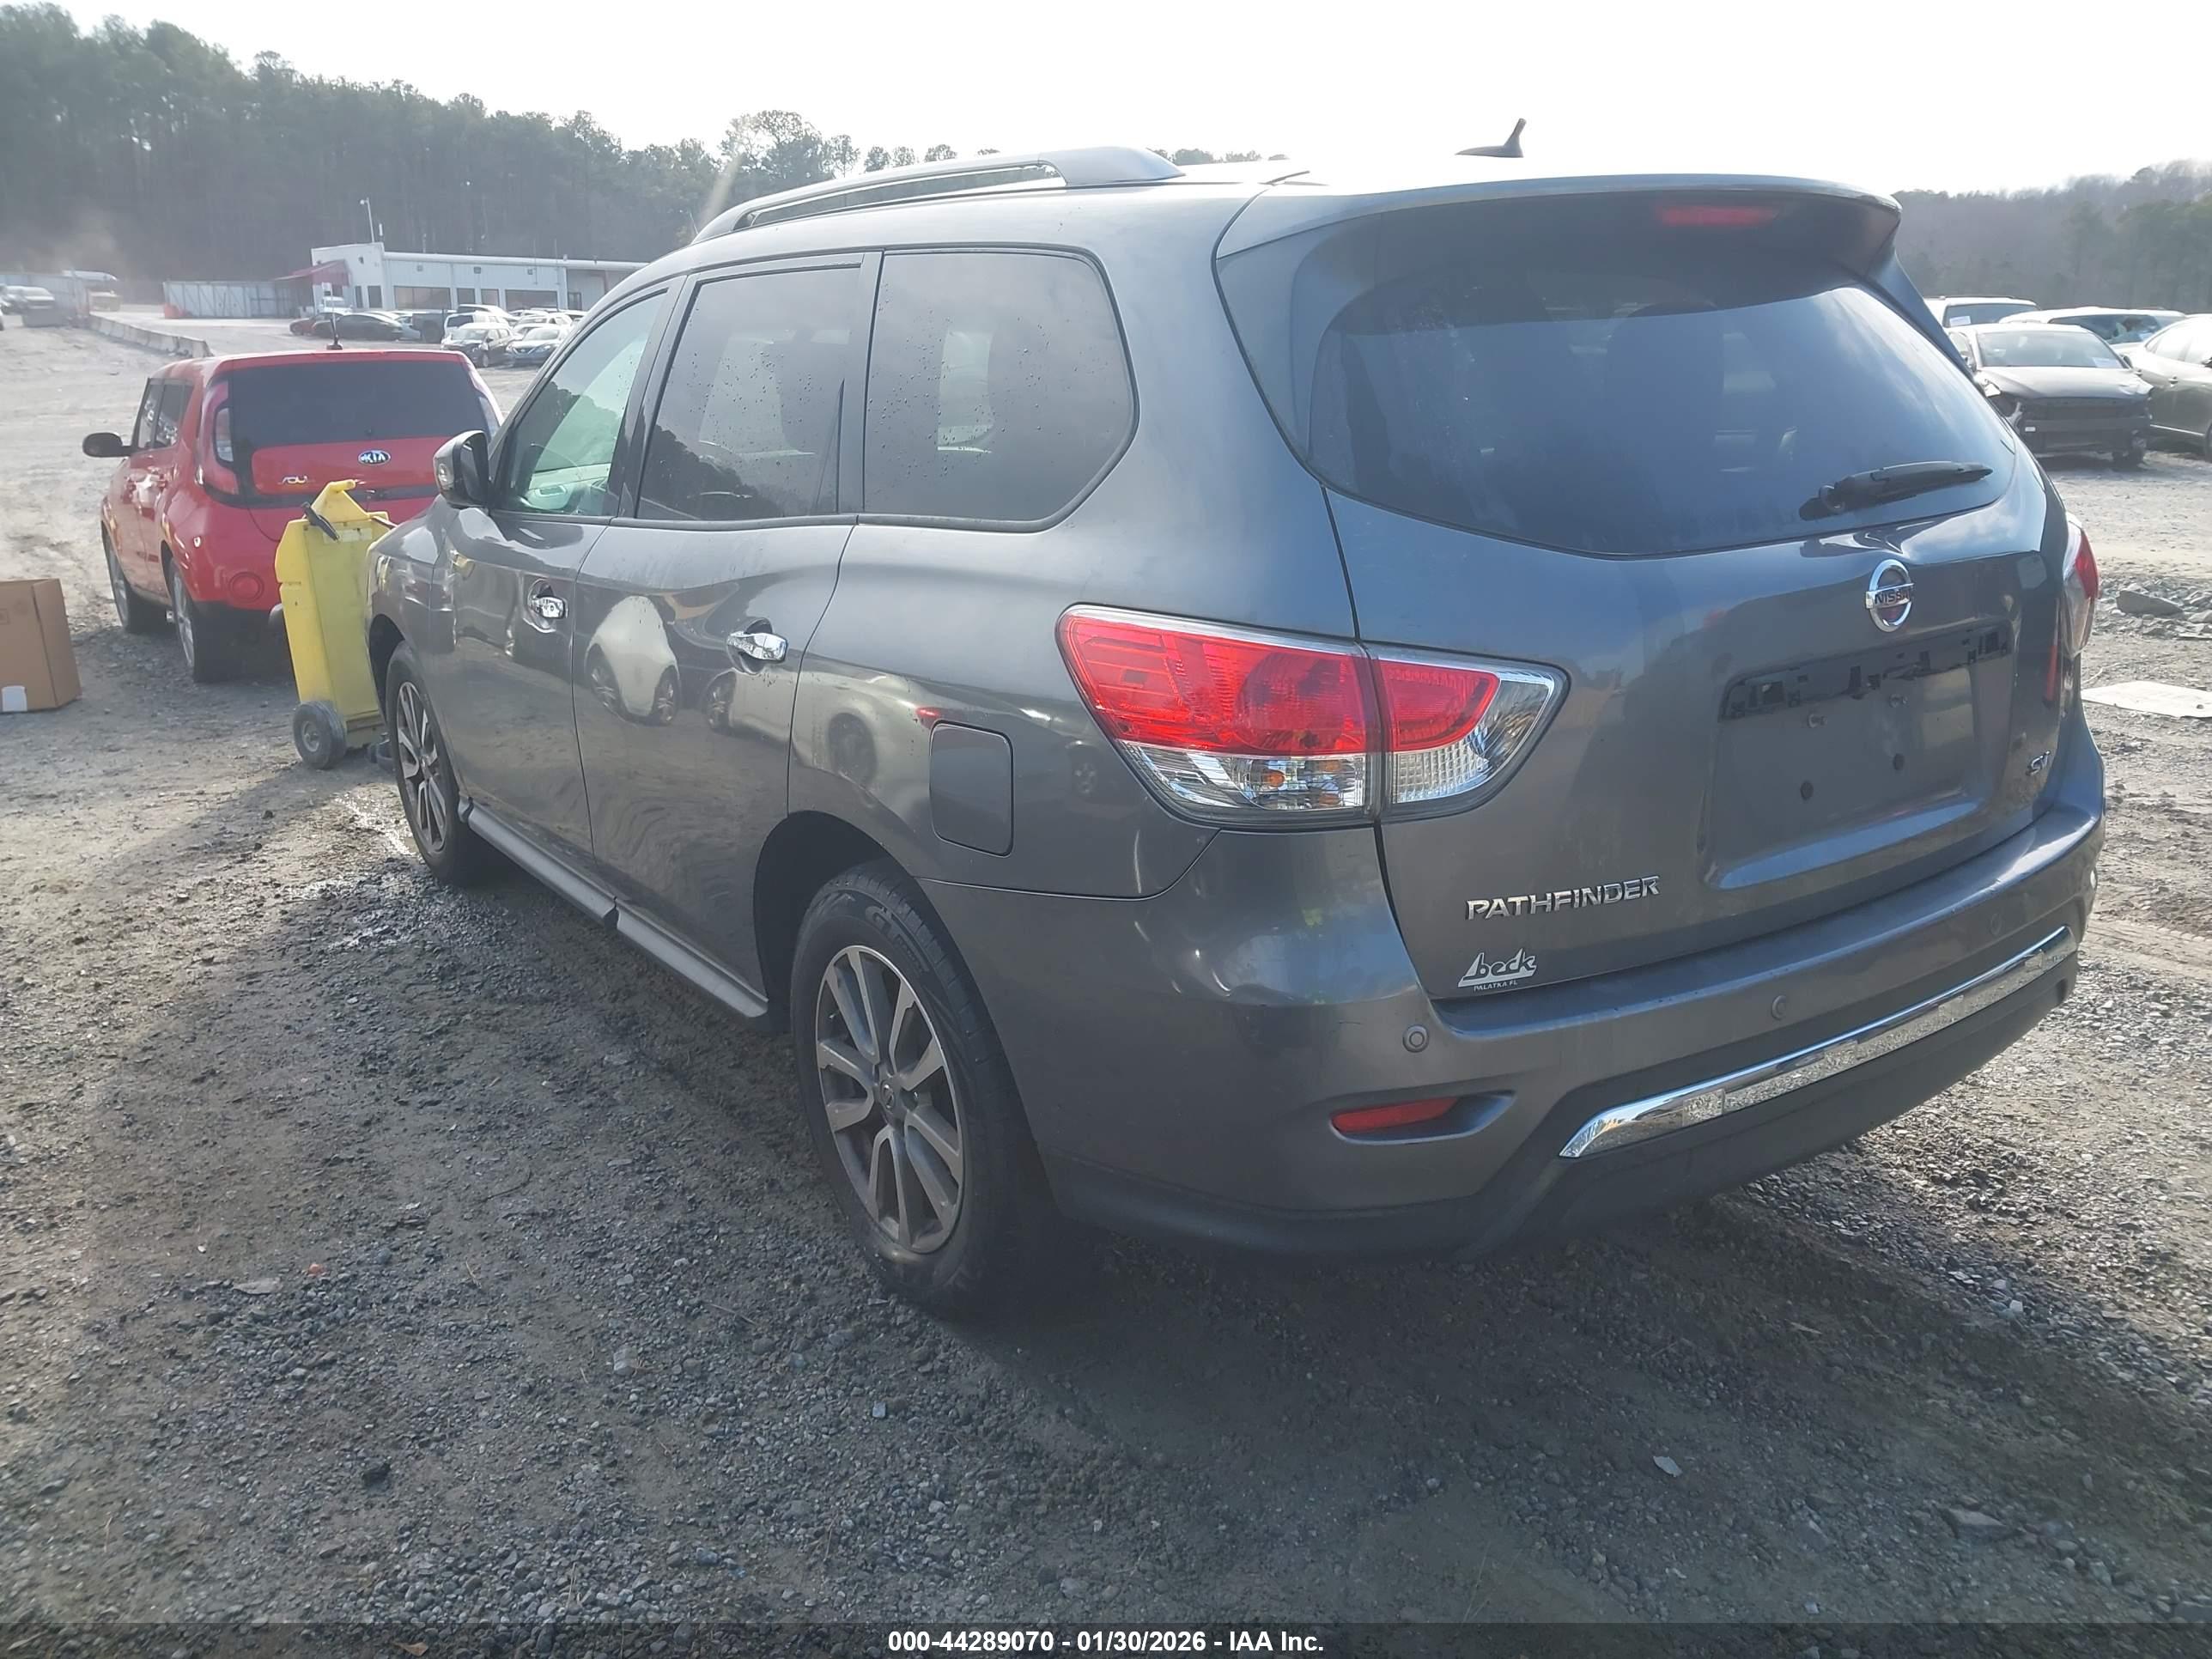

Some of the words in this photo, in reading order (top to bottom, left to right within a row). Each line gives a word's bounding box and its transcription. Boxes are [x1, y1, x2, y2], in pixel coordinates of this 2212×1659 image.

[360, 451, 388, 464] KIA
[2027, 750, 2051, 776] SV
[1465, 874, 1661, 921] PATHFINDER
[1473, 981, 1508, 992] PALATKA
